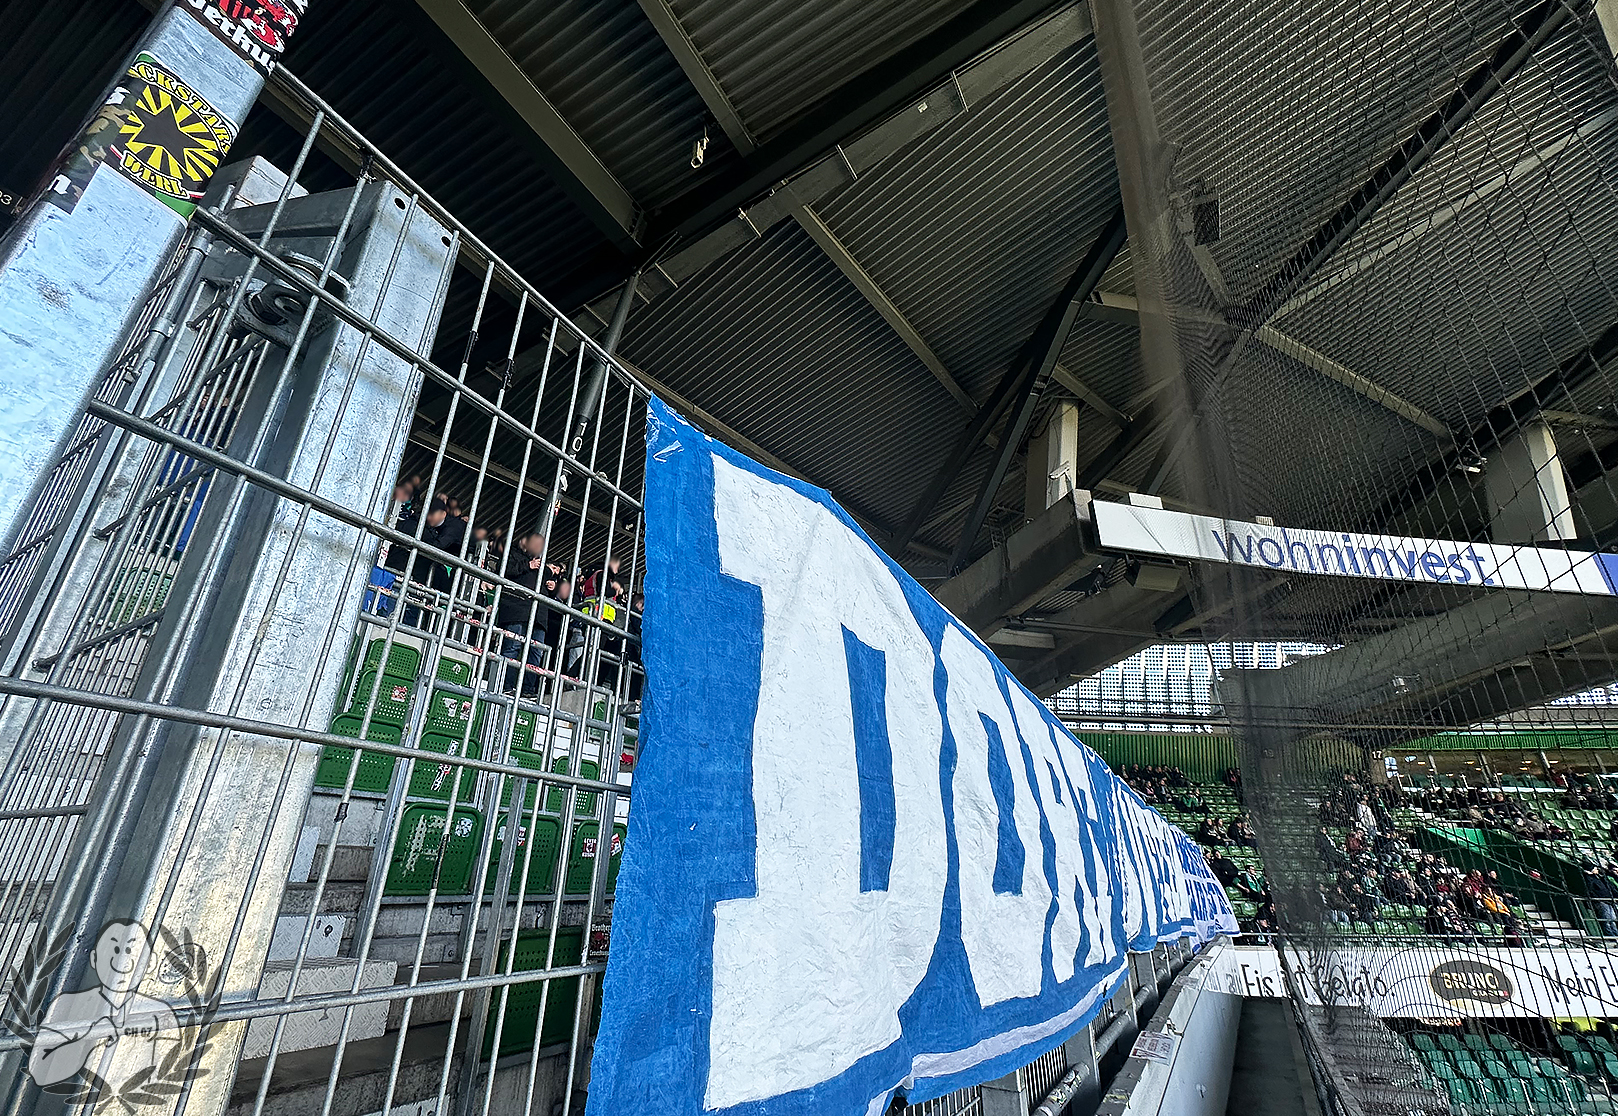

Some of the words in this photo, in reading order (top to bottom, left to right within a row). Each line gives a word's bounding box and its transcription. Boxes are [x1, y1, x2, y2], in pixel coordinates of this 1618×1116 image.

[126, 63, 232, 157] CKSTARS
[1211, 527, 1494, 586] wohninvest
[1543, 966, 1600, 1004] Mein
